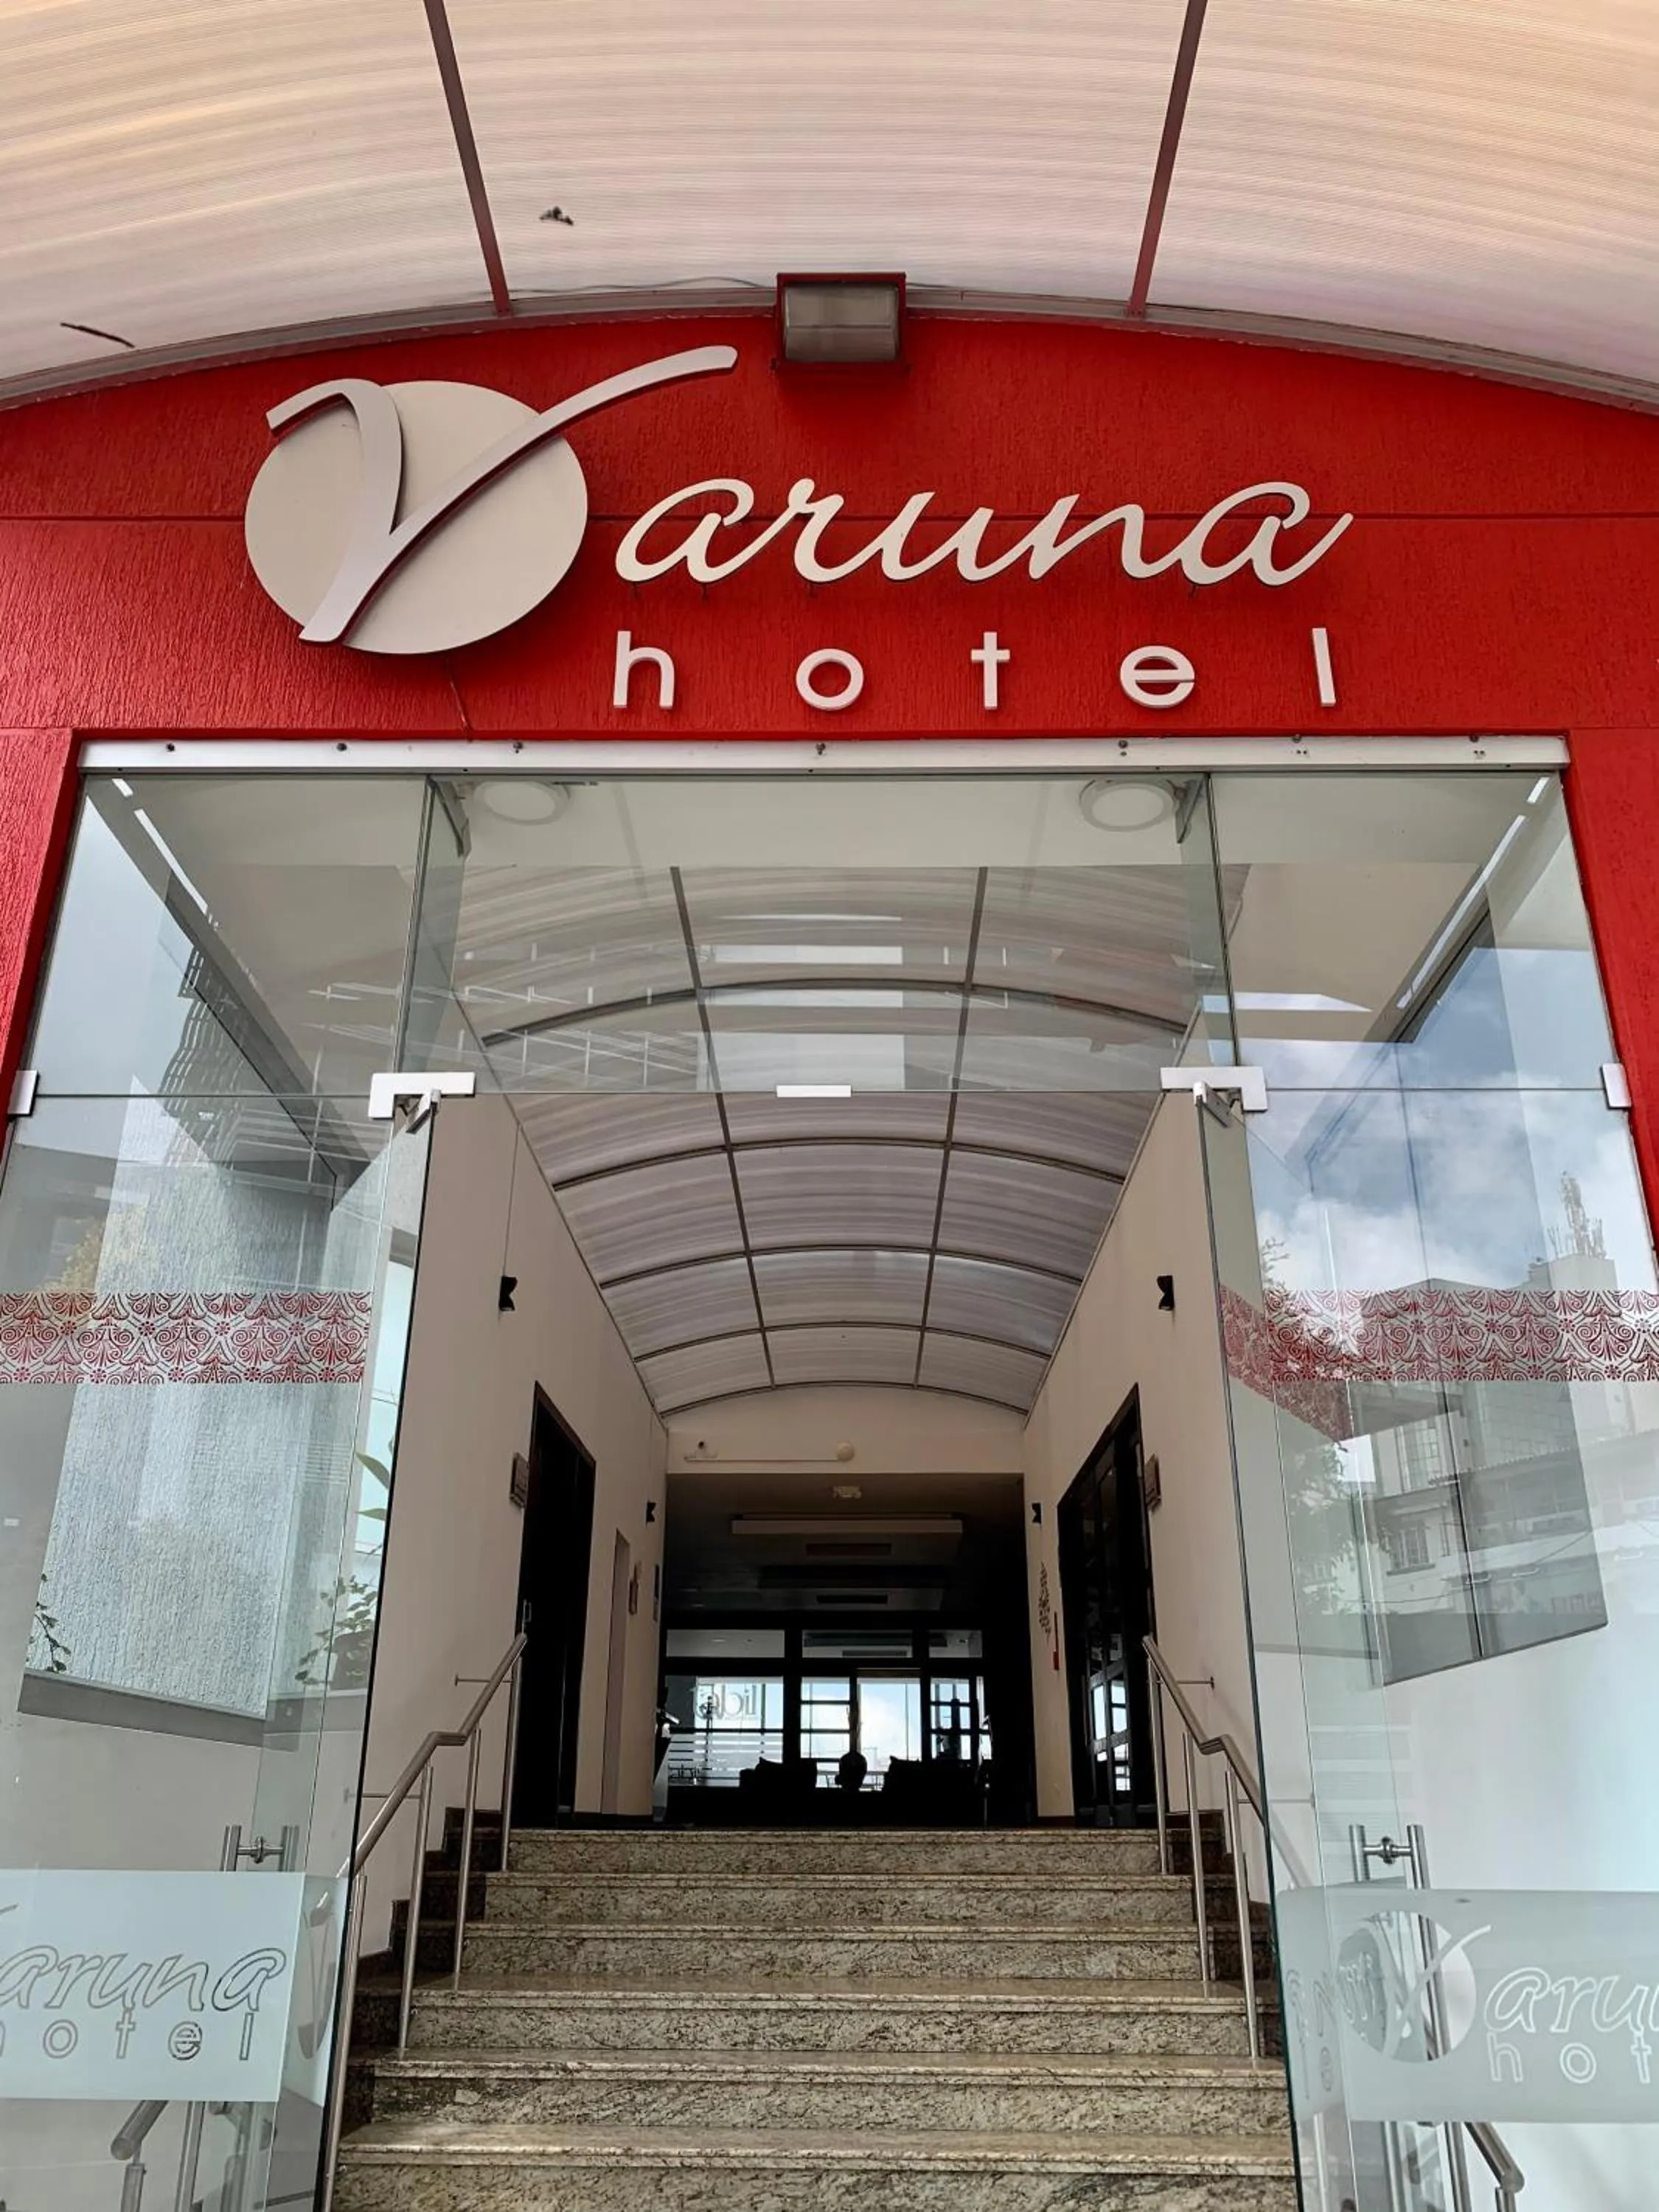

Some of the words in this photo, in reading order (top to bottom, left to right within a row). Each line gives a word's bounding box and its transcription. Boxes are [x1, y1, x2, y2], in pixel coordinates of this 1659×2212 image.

[266, 345, 1354, 645] Varuna
[613, 626, 1336, 709] hotel
[0, 1904, 287, 2011] aruna
[0, 2009, 254, 2061] otel
